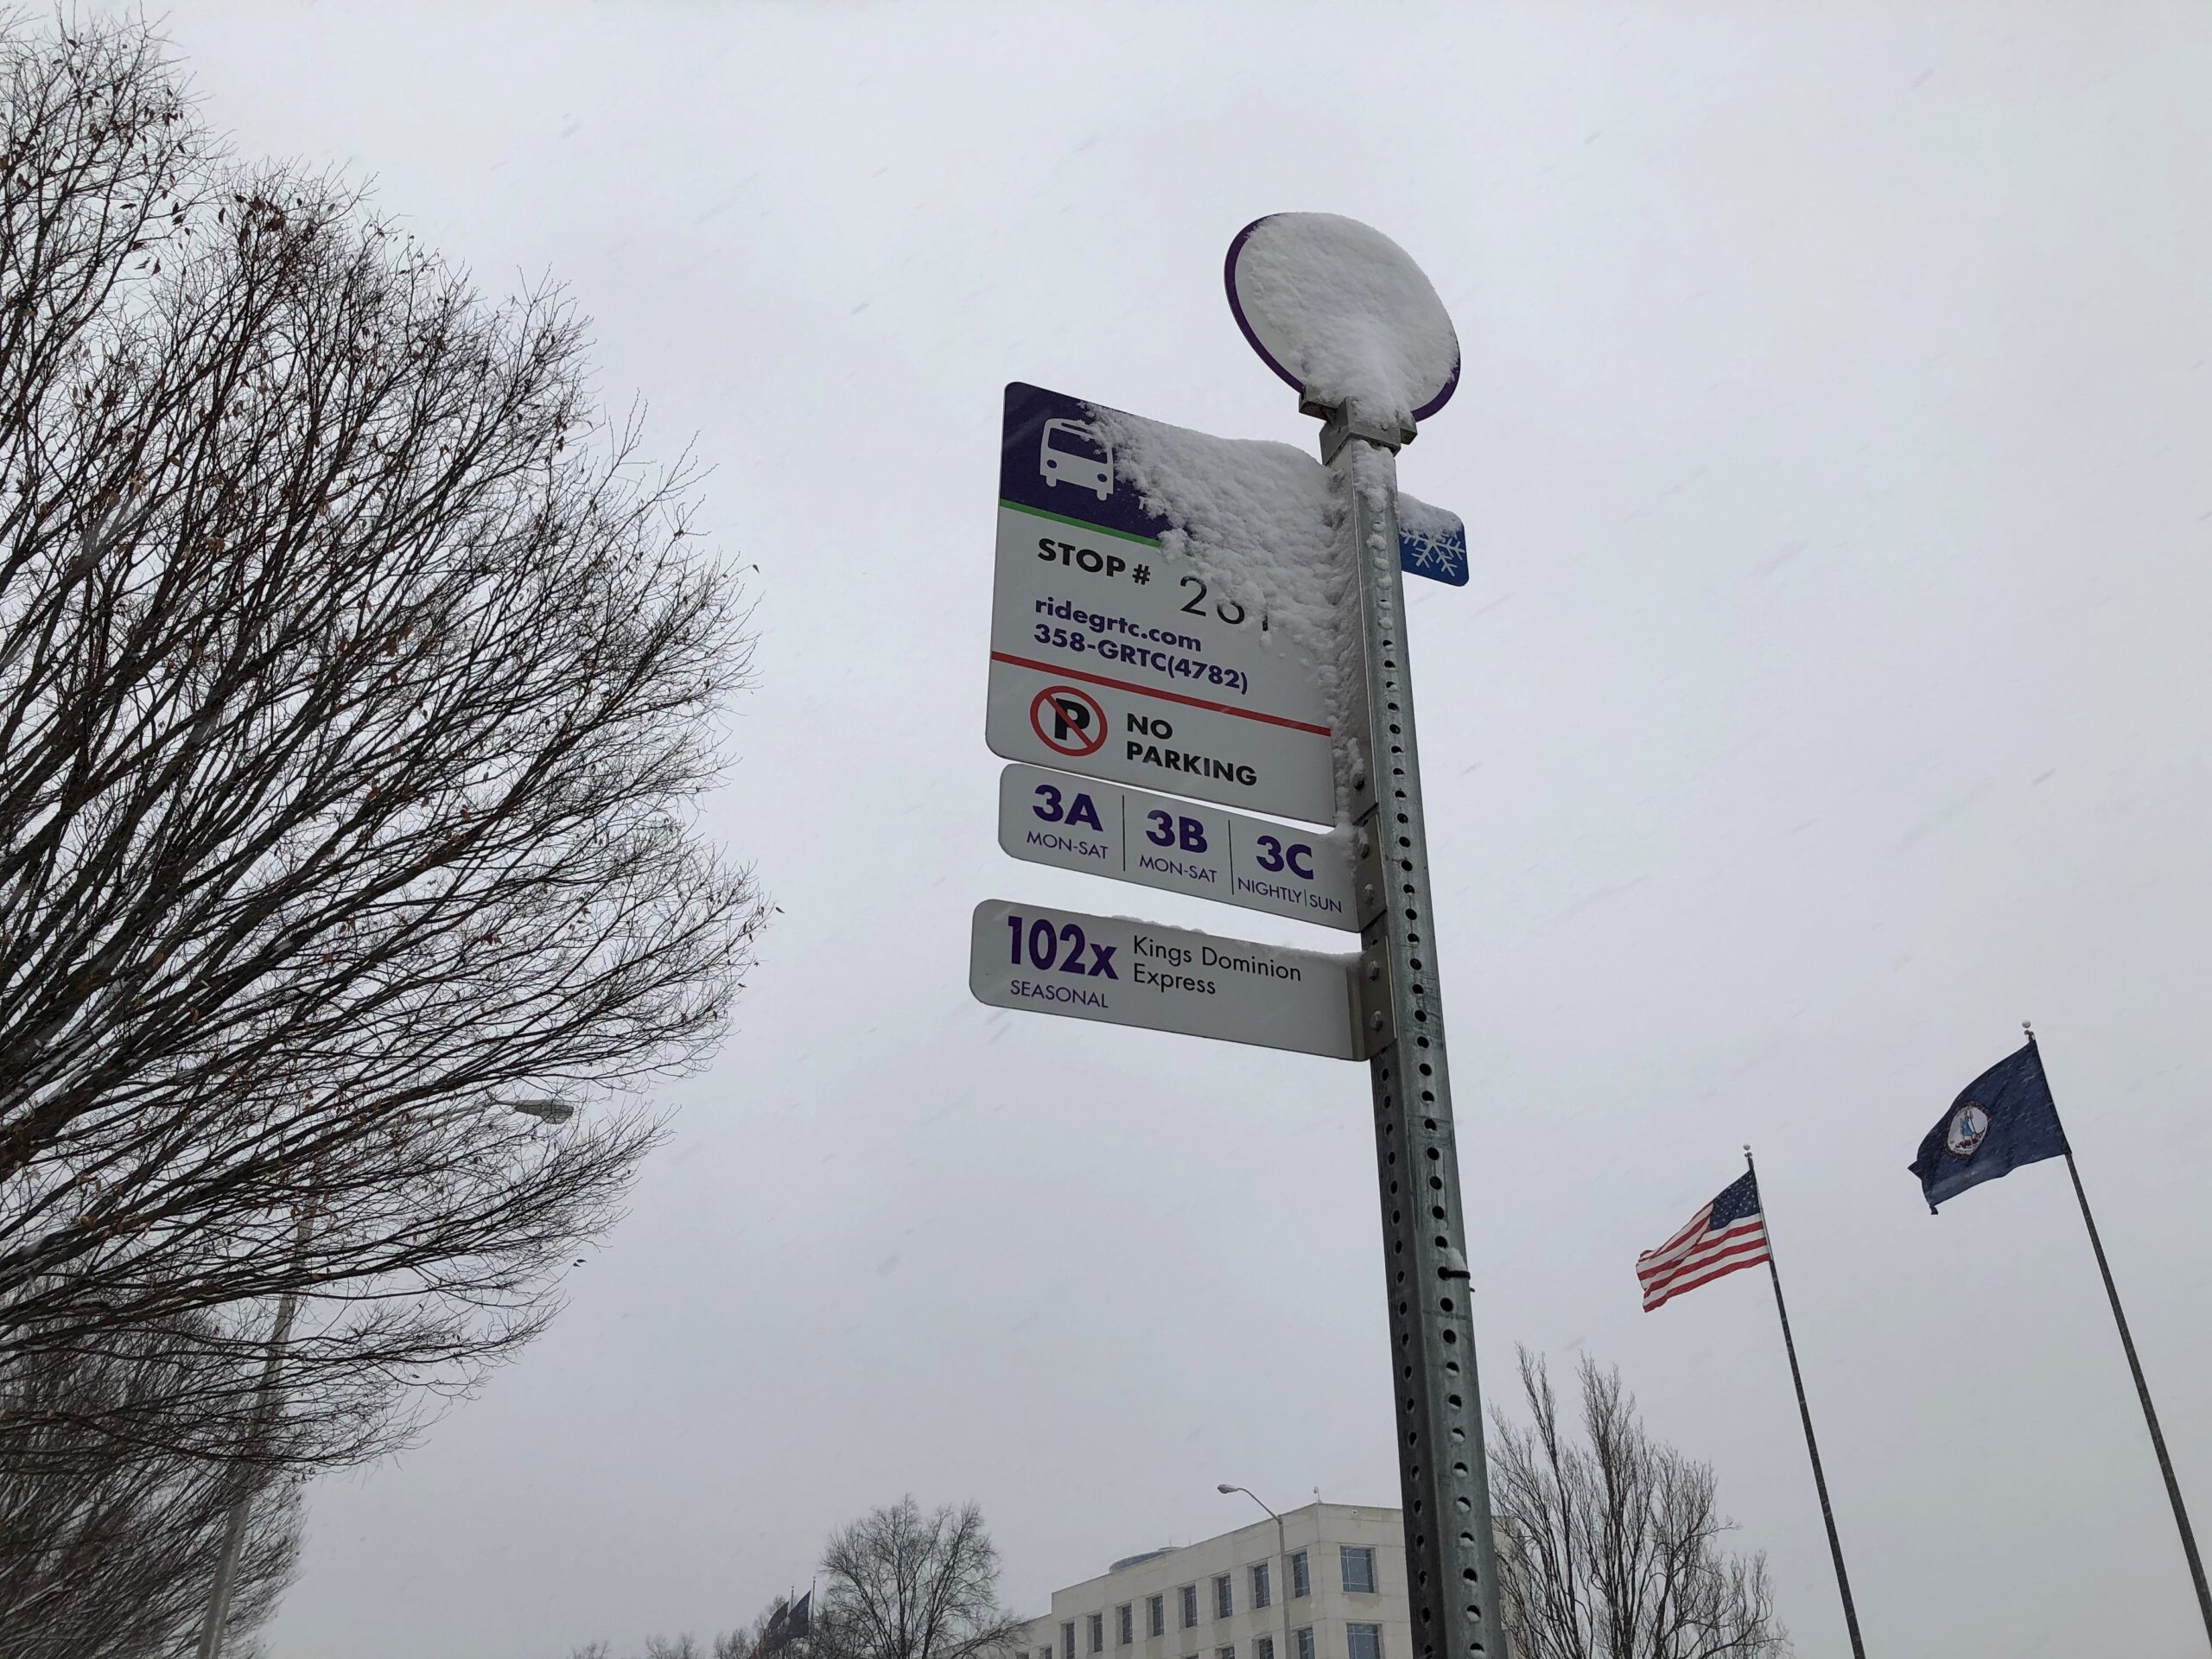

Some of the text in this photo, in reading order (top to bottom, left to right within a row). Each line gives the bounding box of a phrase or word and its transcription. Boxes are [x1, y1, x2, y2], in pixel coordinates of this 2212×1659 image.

[1038, 537, 1126, 577] STOP
[1035, 596, 1202, 652] ridegrtc.com
[1033, 623, 1249, 696] 358-GRTC(4782)
[1127, 713, 1173, 740] NO
[1126, 741, 1257, 786] PARKING
[1032, 784, 1104, 832] 3A
[1026, 831, 1109, 860] MON-SAT
[1145, 809, 1209, 854] 3B
[1139, 855, 1217, 884] MON-SAT
[1255, 835, 1314, 880] 3C
[1007, 915, 1120, 981] 102x
[1134, 935, 1301, 982] Kings Dominion
[1010, 979, 1109, 1009] SEASONAL
[1134, 963, 1216, 995] Express
